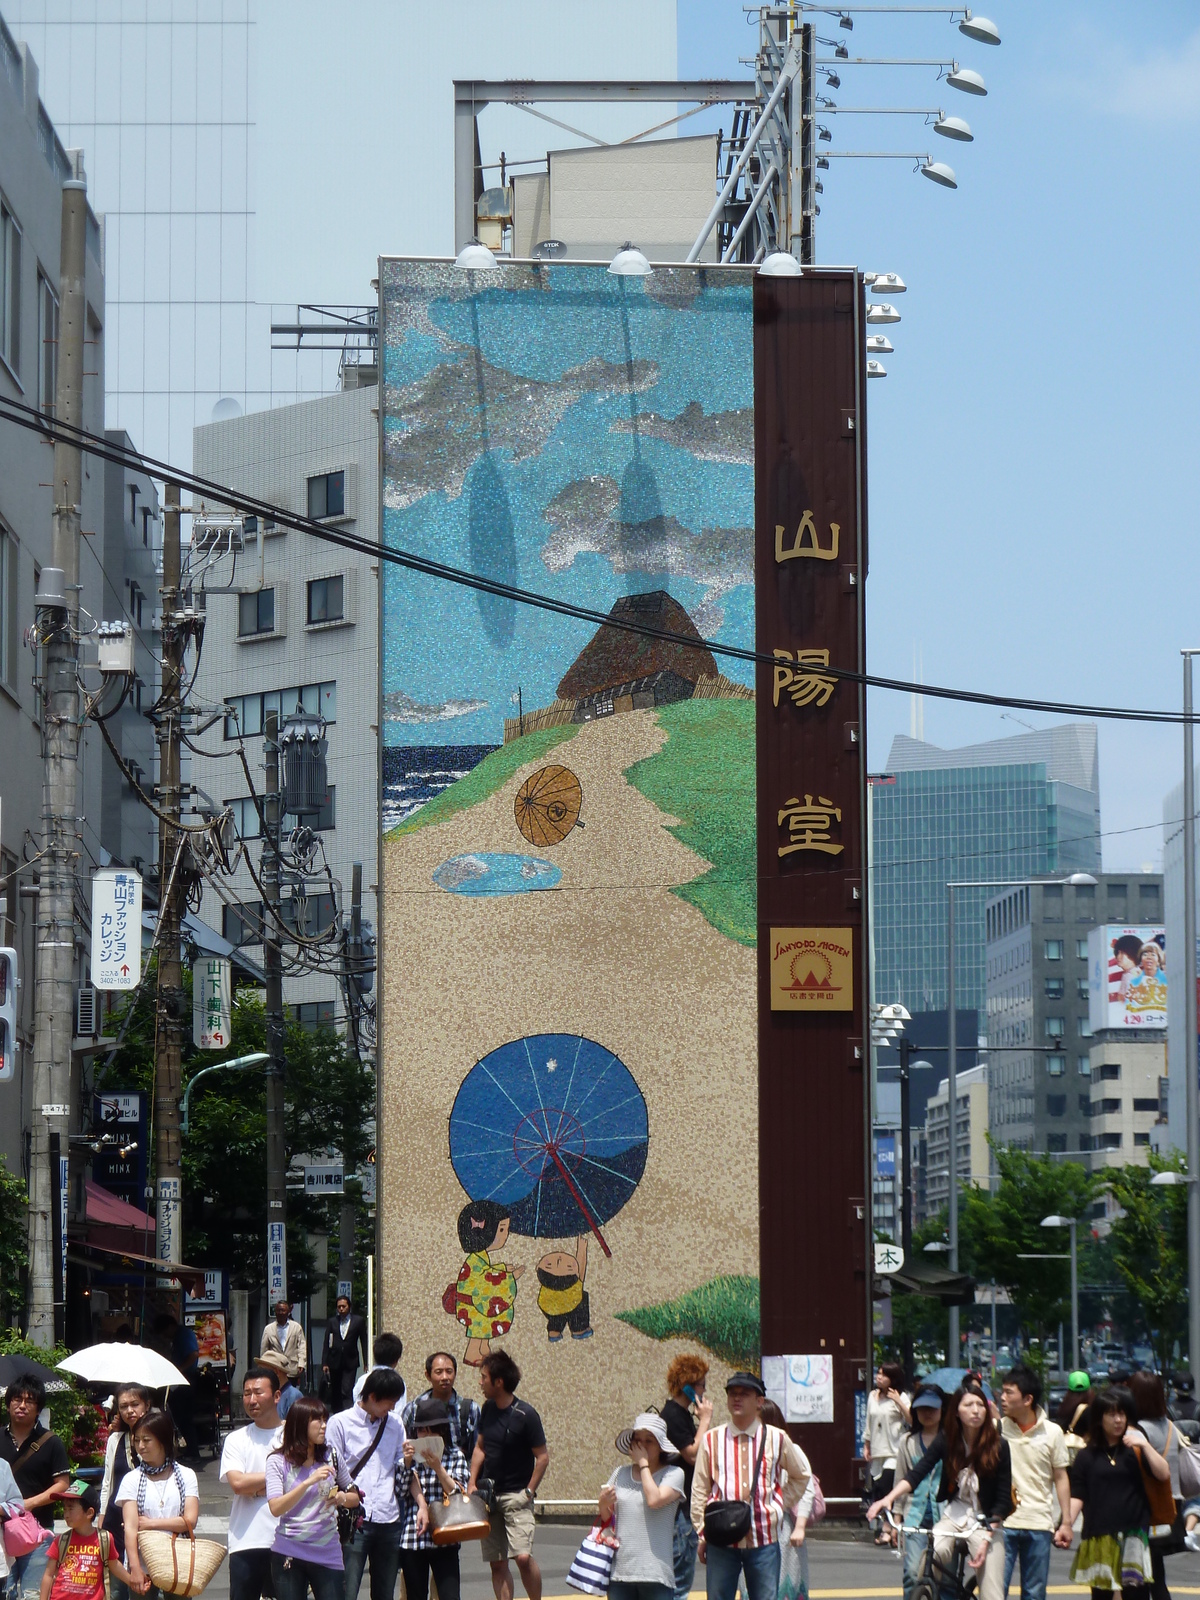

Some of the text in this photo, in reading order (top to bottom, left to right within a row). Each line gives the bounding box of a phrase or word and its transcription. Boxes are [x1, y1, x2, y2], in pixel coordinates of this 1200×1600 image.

[773, 509, 844, 857] 山陽堂
[113, 874, 127, 962] 青山ファッション
[100, 913, 113, 962] カレッジ
[817, 941, 850, 958] SHOTEN
[207, 960, 221, 1030] 山下歯科
[109, 1163, 131, 1174] MINX
[877, 1248, 900, 1269] 本
[67, 1545, 100, 1555] CLUCK
